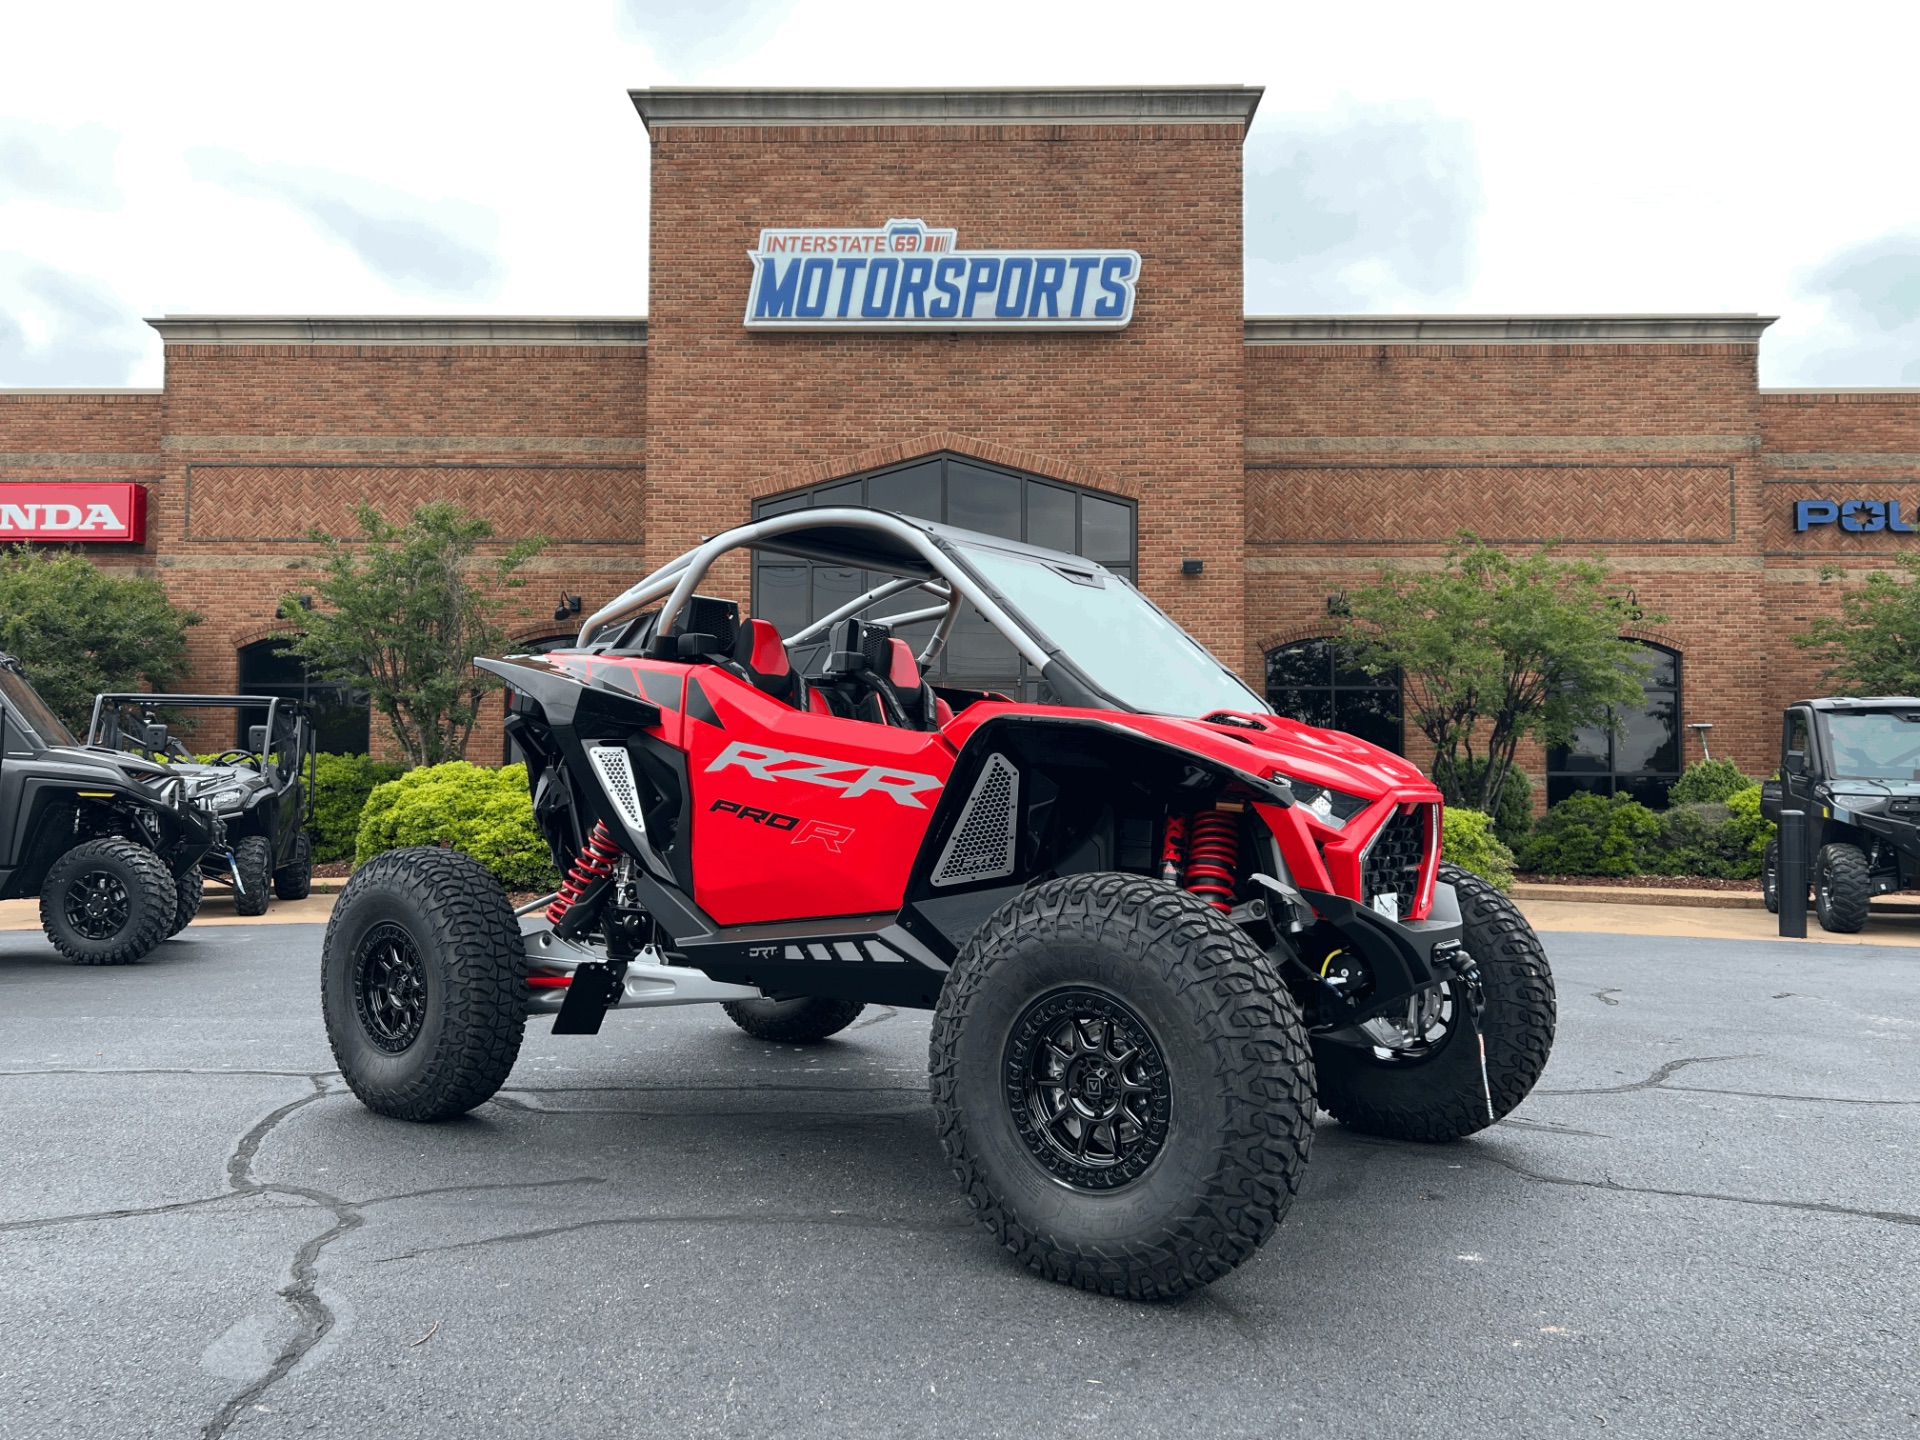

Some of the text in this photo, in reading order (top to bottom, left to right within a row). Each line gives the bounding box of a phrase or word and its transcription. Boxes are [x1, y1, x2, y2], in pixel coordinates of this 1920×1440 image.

[766, 235, 918, 253] INTERSTATE 69
[754, 257, 1135, 318] MOTORSPORTS
[0, 503, 126, 530] NDA
[704, 740, 945, 810] RZR
[709, 798, 856, 853] PRO R
